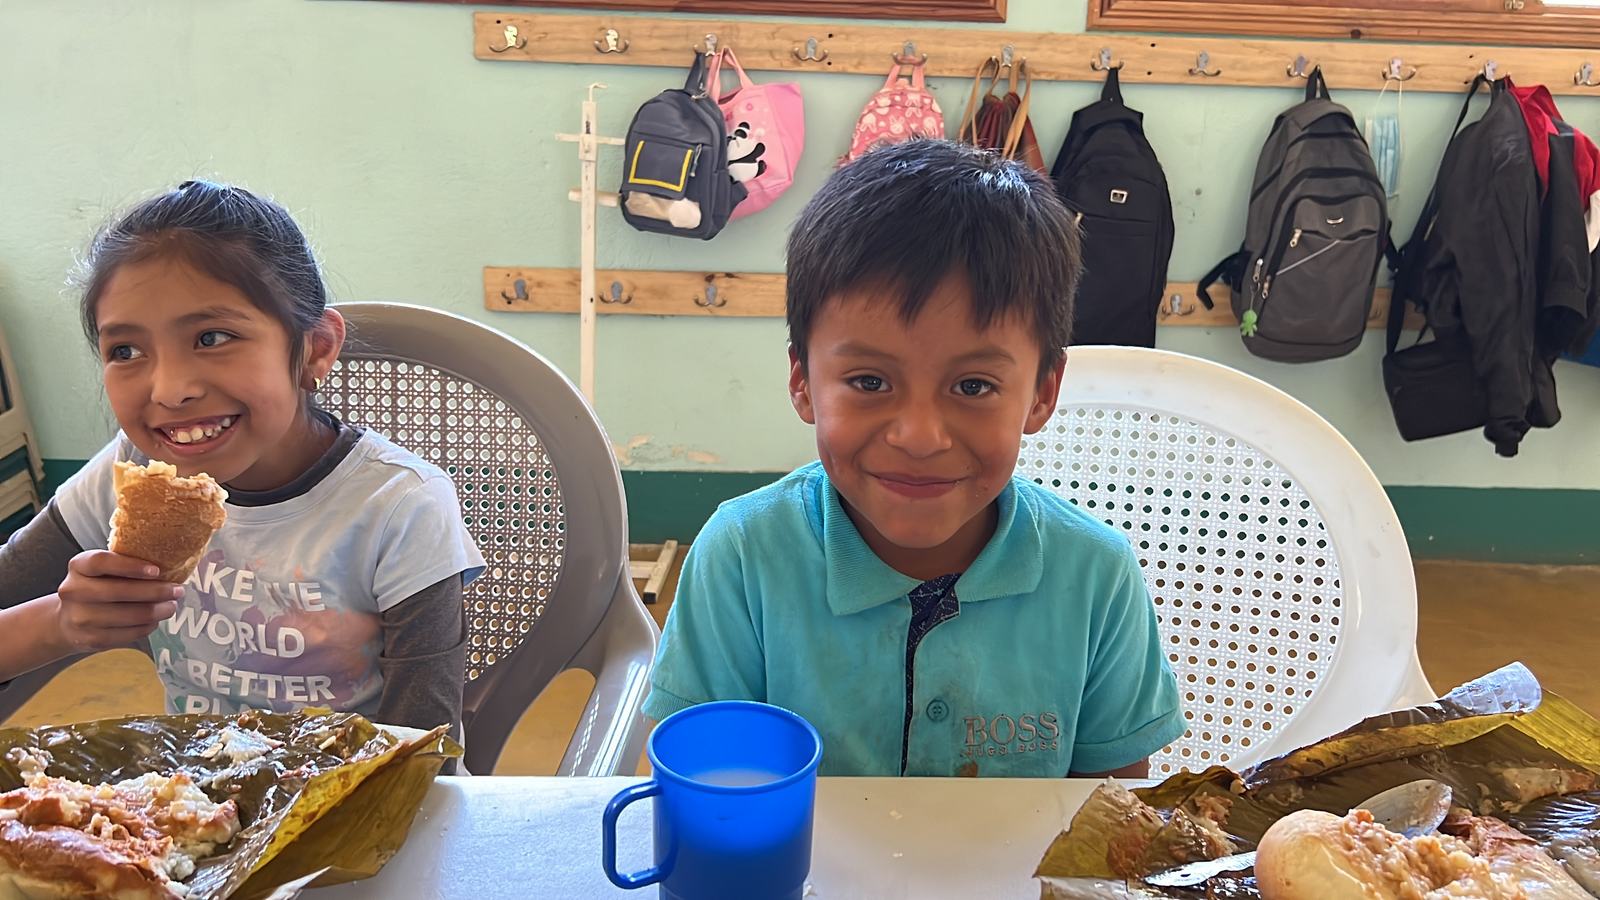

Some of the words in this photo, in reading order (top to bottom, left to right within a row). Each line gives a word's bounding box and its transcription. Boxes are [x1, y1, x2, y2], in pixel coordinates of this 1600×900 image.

[184, 562, 255, 602] AKE
[167, 607, 305, 659] WORLD
[158, 648, 173, 674] A
[187, 659, 335, 702] BETTER
[963, 712, 1060, 746] BOSS
